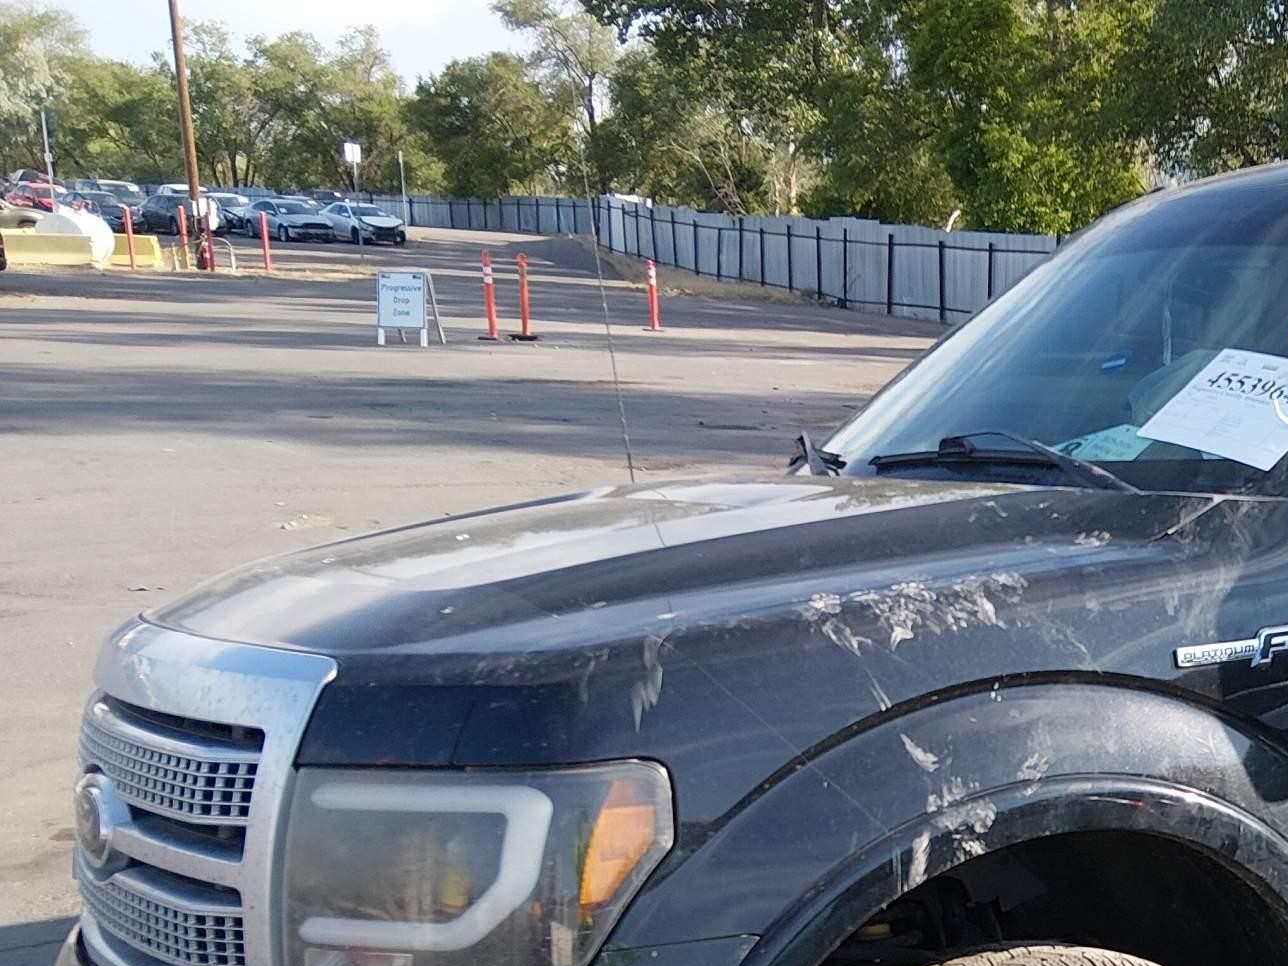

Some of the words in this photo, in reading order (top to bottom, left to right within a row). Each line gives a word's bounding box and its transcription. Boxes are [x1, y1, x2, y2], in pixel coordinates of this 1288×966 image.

[381, 284, 421, 292] Progressive
[393, 296, 410, 304] Drop
[1183, 645, 1255, 662] PLATINUM
